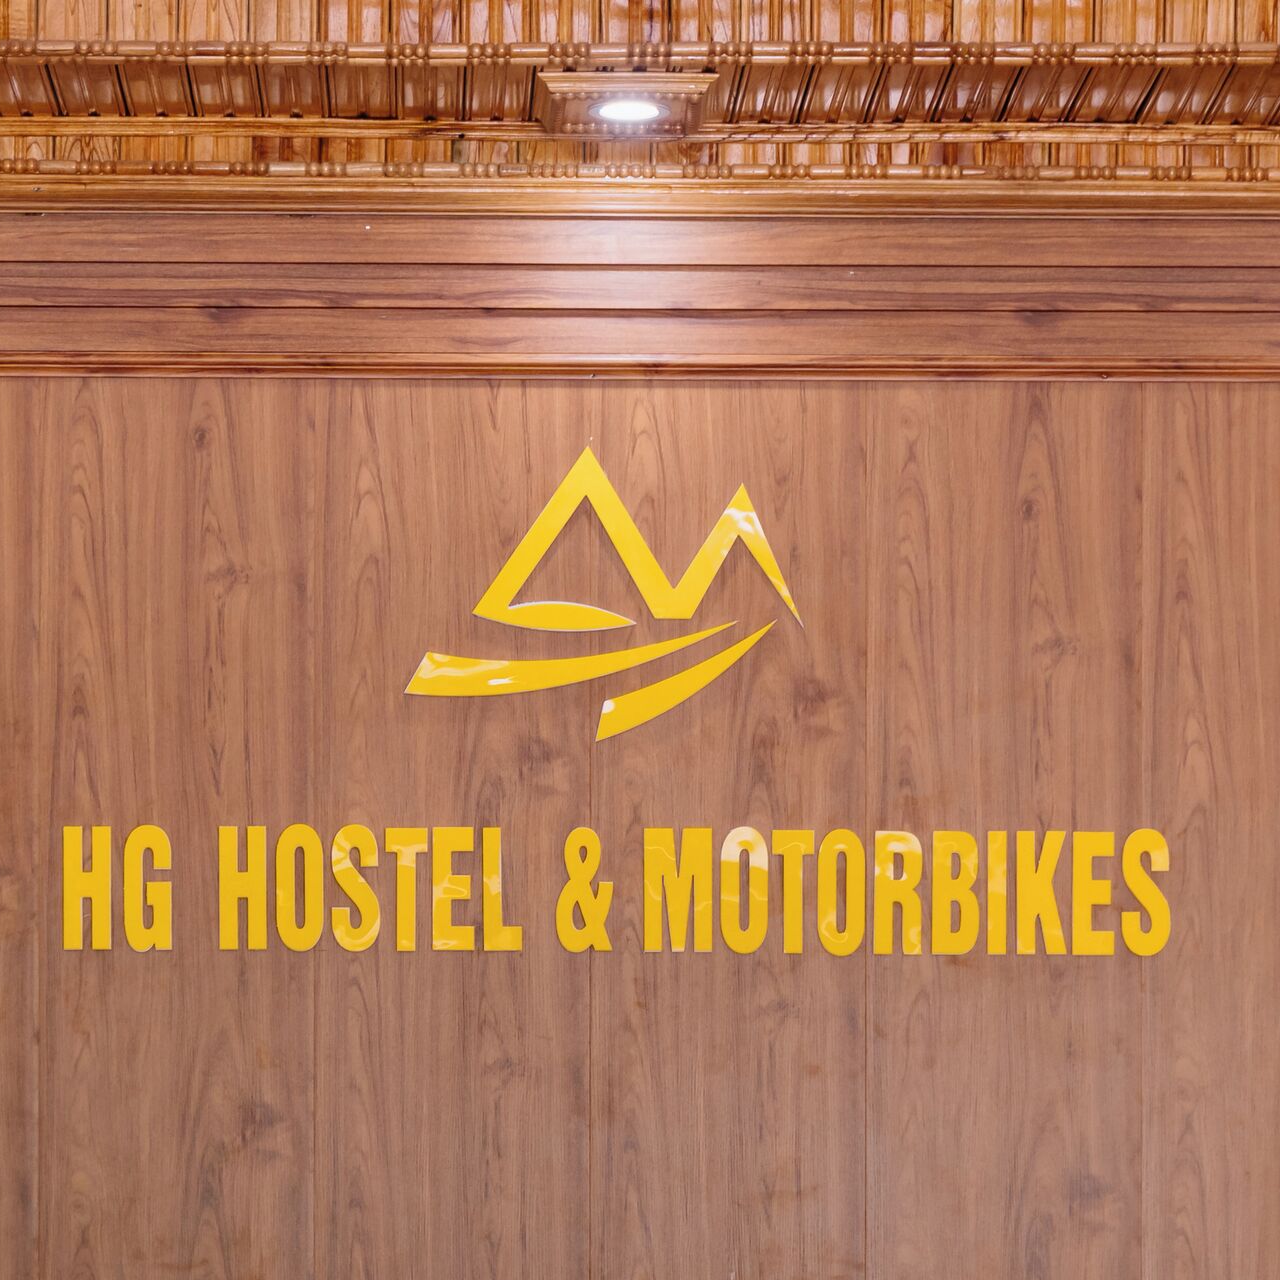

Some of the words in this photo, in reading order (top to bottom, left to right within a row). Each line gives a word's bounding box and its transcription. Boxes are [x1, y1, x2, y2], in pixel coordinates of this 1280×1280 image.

[62, 824, 172, 952] HG
[218, 823, 523, 952] HOSTEL
[556, 828, 614, 953] &
[643, 827, 1171, 956] MOTORBIKES
